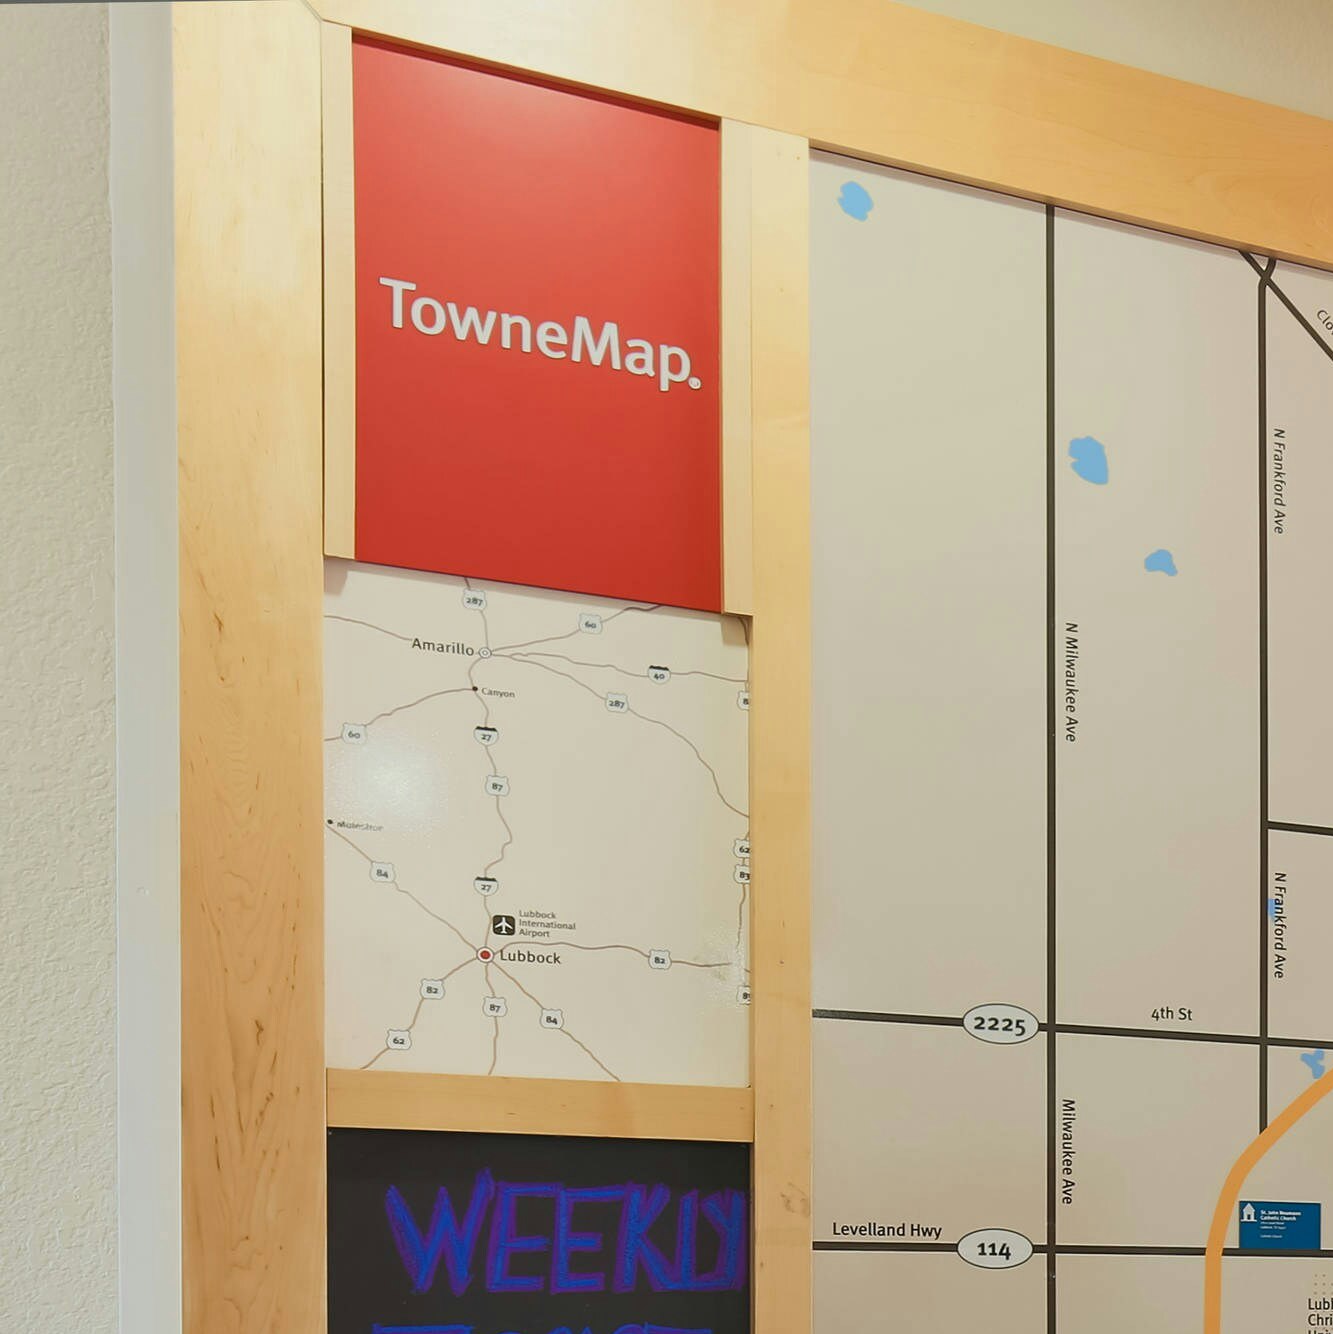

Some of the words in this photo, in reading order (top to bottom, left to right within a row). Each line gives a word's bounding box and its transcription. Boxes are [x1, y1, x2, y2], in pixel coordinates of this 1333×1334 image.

[1274, 429, 1285, 438] N
[1274, 442, 1286, 506] Frankford
[1274, 510, 1285, 534] Ave
[1066, 623, 1078, 632] N
[412, 638, 474, 656] Amarillo
[1066, 637, 1079, 712] Milwaukee
[481, 687, 516, 700] Canyon
[348, 731, 360, 739] 60
[1066, 716, 1078, 741] Ave
[492, 783, 503, 791] 87
[377, 869, 388, 878] 84
[519, 910, 556, 920] Lubbock
[519, 920, 576, 931] International
[519, 929, 549, 938] Airport
[500, 949, 560, 964] Lubbock
[427, 986, 438, 994] 82
[1152, 1007, 1173, 1021] 4th
[1179, 1008, 1192, 1020] St
[973, 1017, 1025, 1037] 2225
[1063, 1100, 1075, 1171] Milwaukee
[1062, 1179, 1075, 1204] Ave
[833, 1223, 903, 1236] Levelland
[911, 1224, 942, 1240] Hwy
[978, 1243, 1011, 1260] 114
